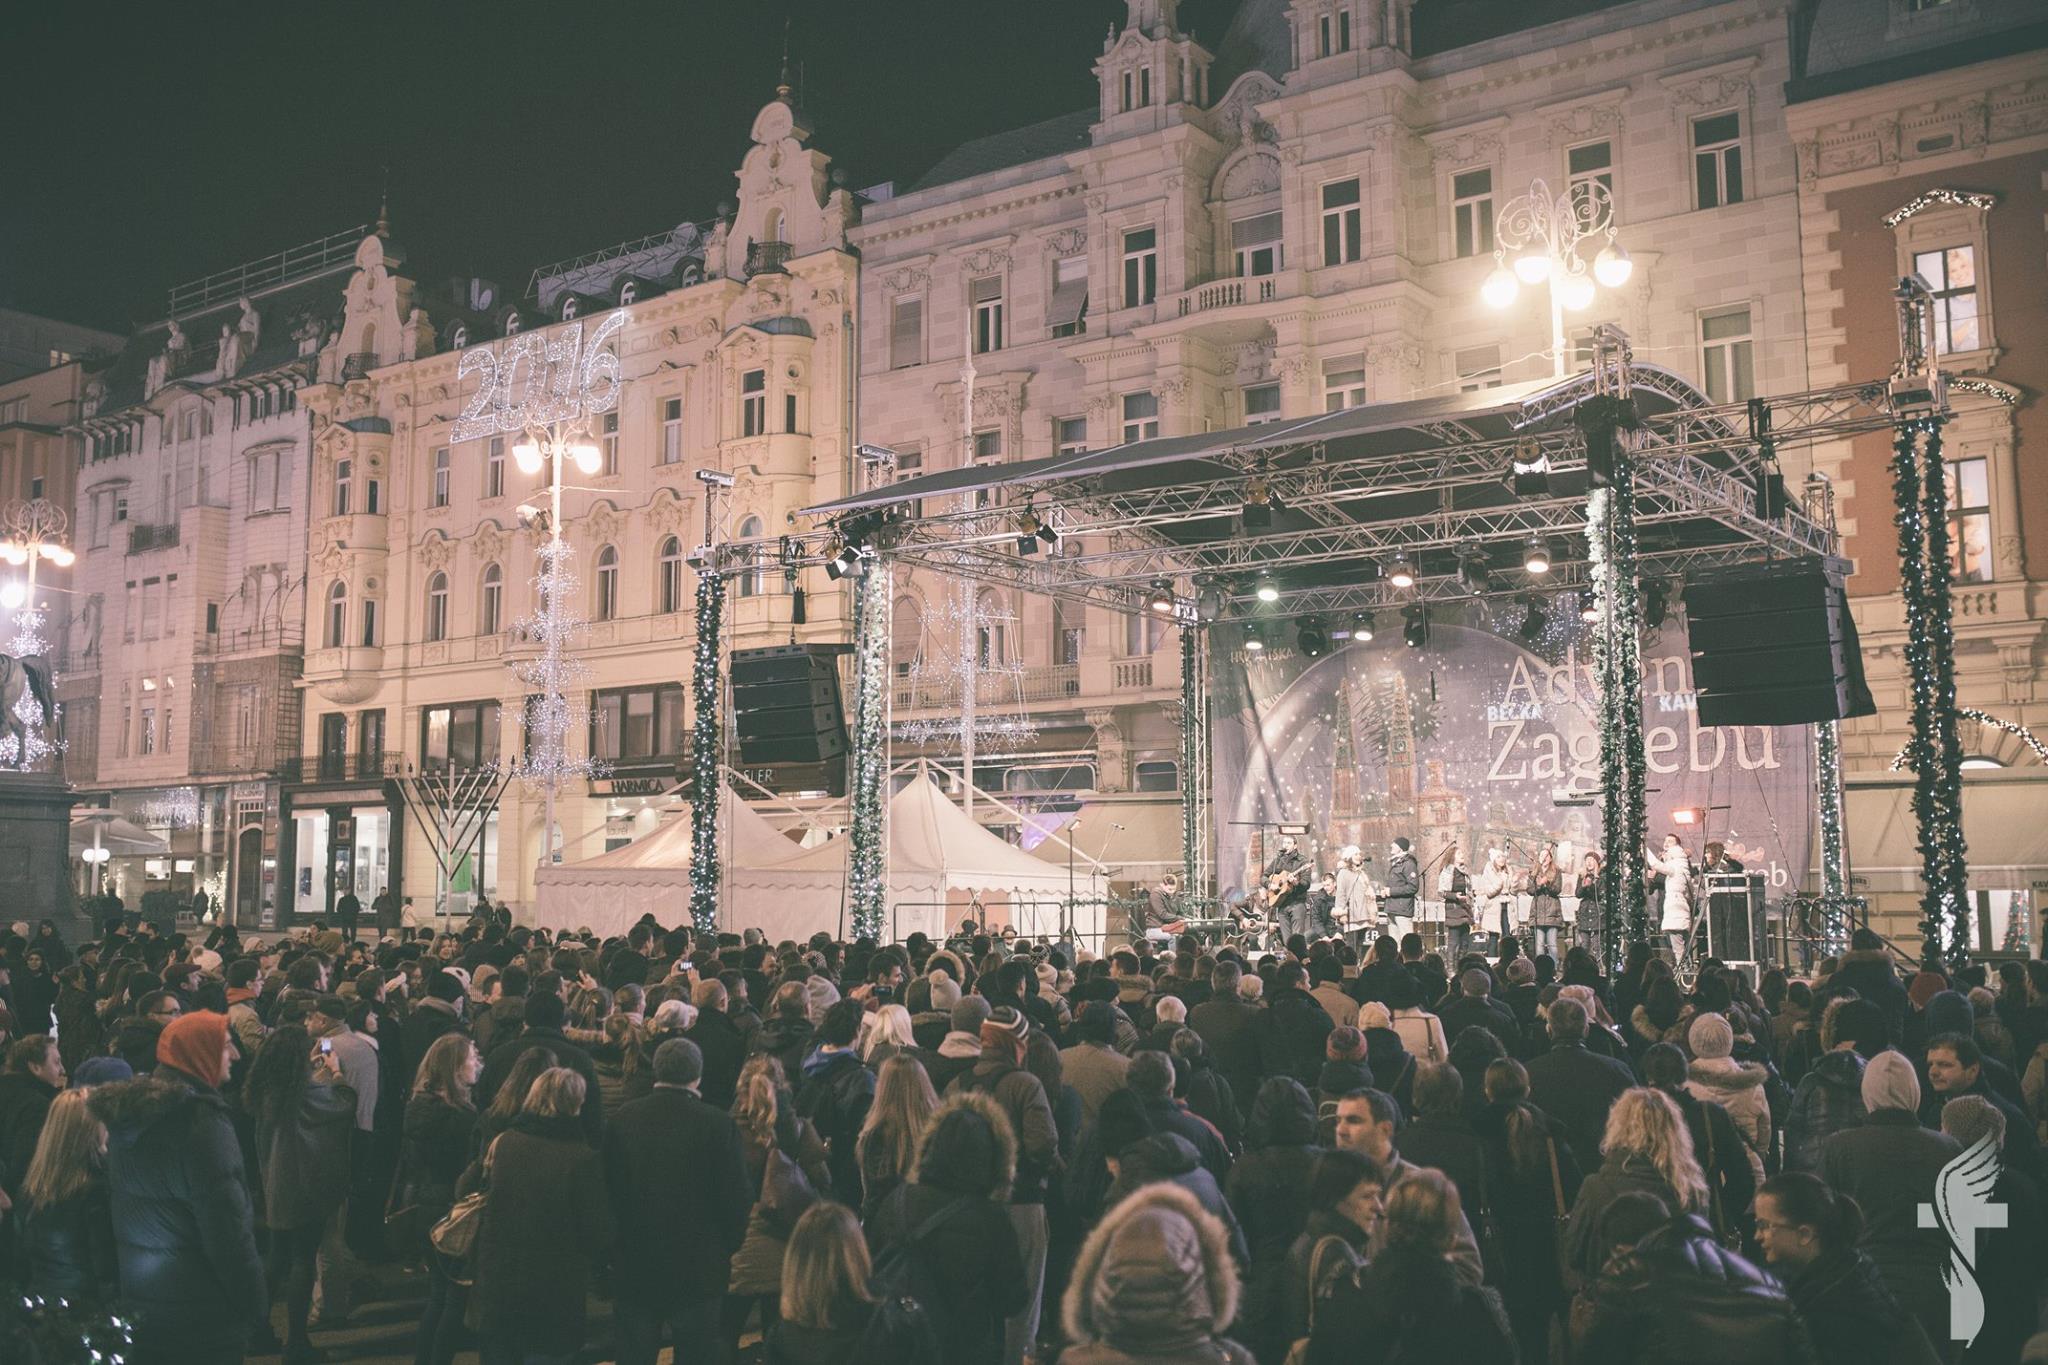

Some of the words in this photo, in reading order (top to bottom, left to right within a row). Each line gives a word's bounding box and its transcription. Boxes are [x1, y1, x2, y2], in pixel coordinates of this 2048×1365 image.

[450, 308, 627, 444] 2016
[1231, 647, 1294, 664] HRVTSKA
[1487, 698, 1781, 793] Zagebu
[611, 778, 665, 793] HARMICA
